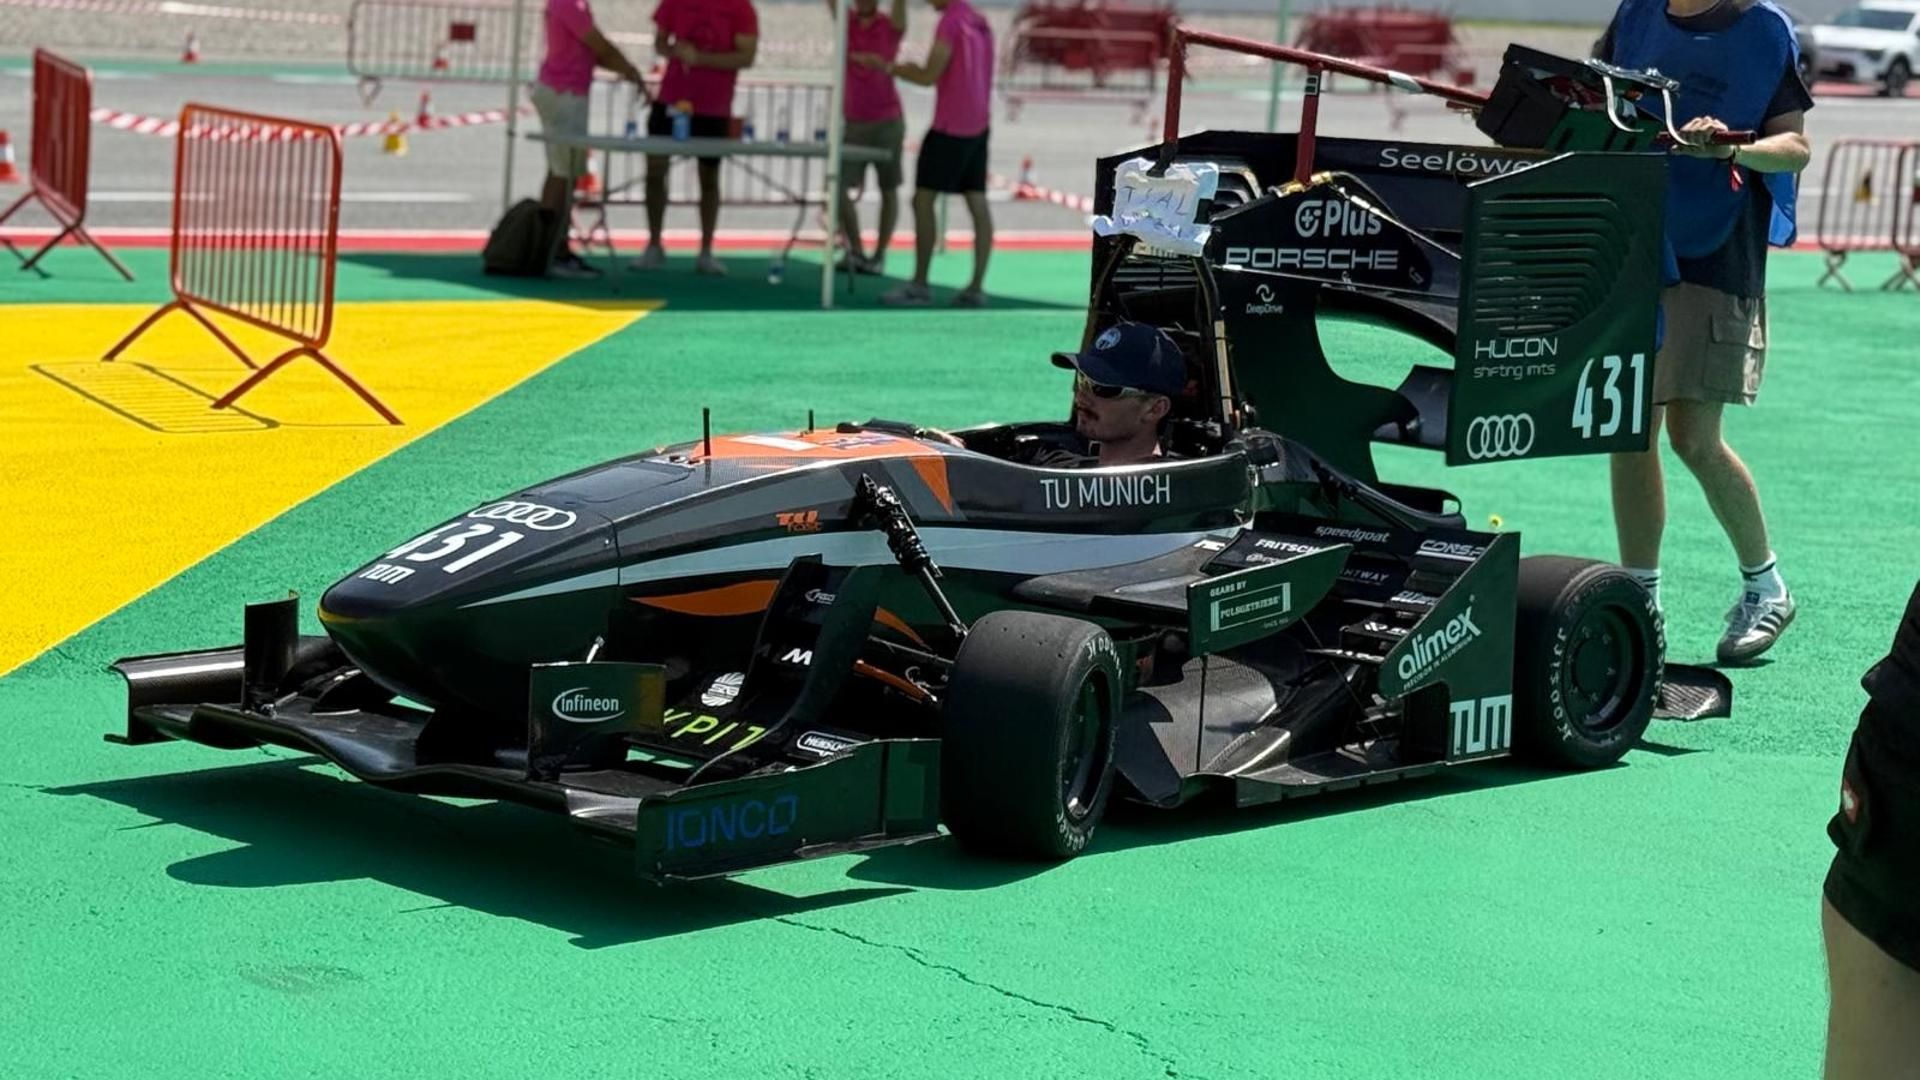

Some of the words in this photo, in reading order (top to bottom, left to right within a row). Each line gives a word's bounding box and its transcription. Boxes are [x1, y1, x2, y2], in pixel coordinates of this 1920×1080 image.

[1323, 199, 1383, 238] Plus
[1224, 246, 1400, 271] PORSCHE
[1245, 303, 1284, 315] DeepDrive
[1474, 337, 1559, 360] HUCON
[1571, 352, 1647, 440] 431
[1040, 477, 1071, 509] TU
[1078, 473, 1171, 508] MUNICH
[1315, 526, 1392, 544] speedgoat
[382, 521, 526, 575] 431
[1209, 583, 1235, 598] GEARS
[1235, 580, 1248, 592] BY
[1397, 605, 1482, 681] alimex
[561, 694, 620, 713] Infineon
